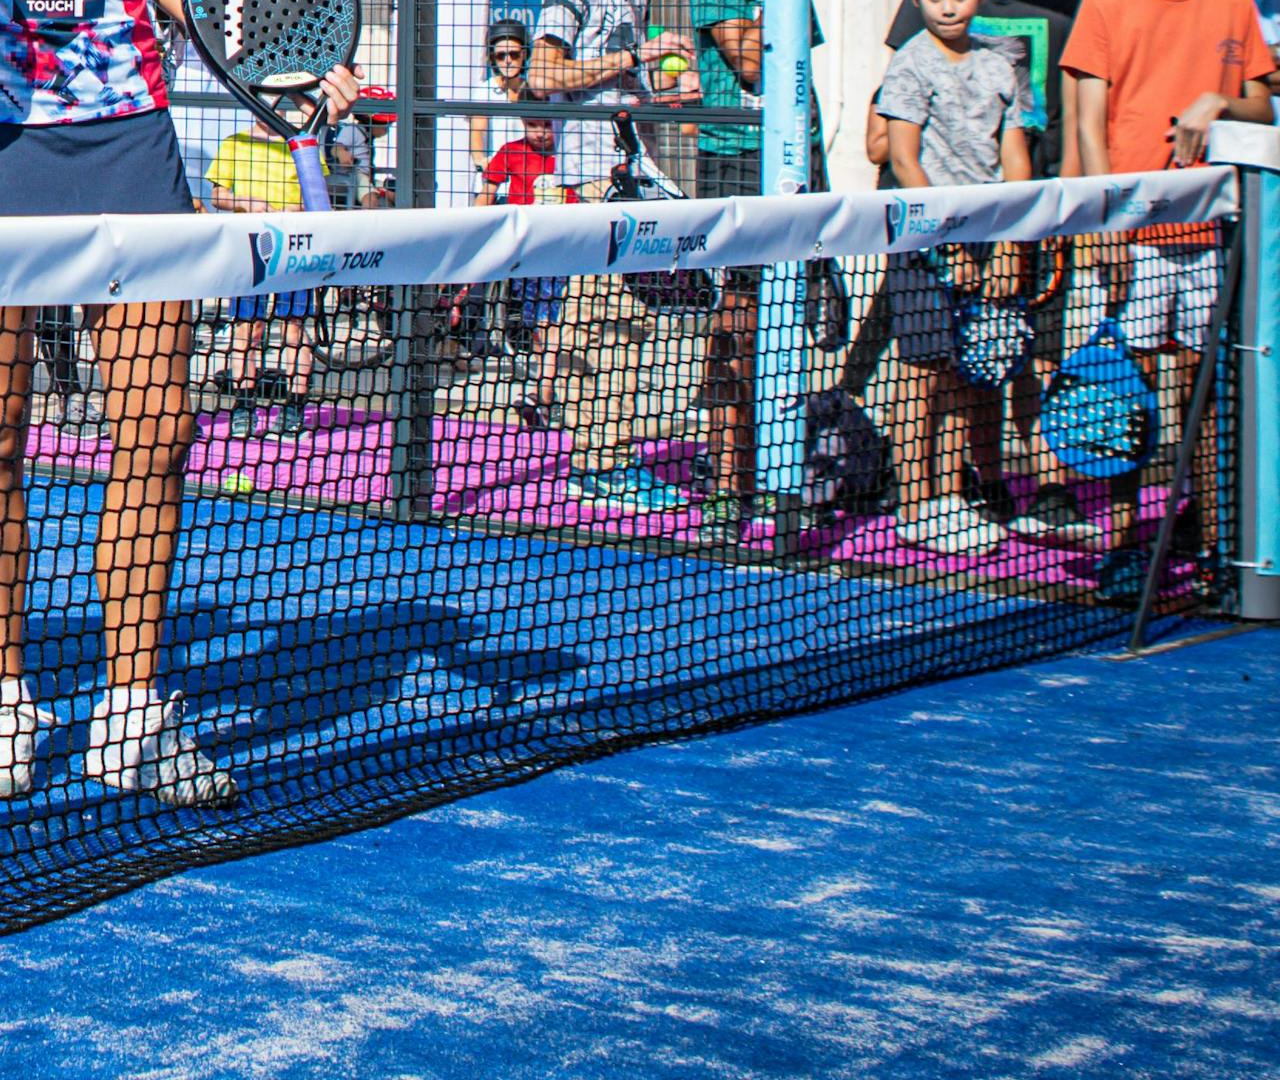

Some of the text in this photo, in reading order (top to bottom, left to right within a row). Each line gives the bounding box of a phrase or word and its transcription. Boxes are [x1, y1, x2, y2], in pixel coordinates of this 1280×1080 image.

[26, 0, 74, 12] TOUCH
[795, 60, 806, 167] PADEL TOUR
[784, 141, 793, 166] FFT
[637, 221, 657, 236] FFT
[288, 234, 313, 251] FFT
[632, 234, 707, 255] PADEL TOUR
[286, 251, 384, 273] PADEL TOUR
